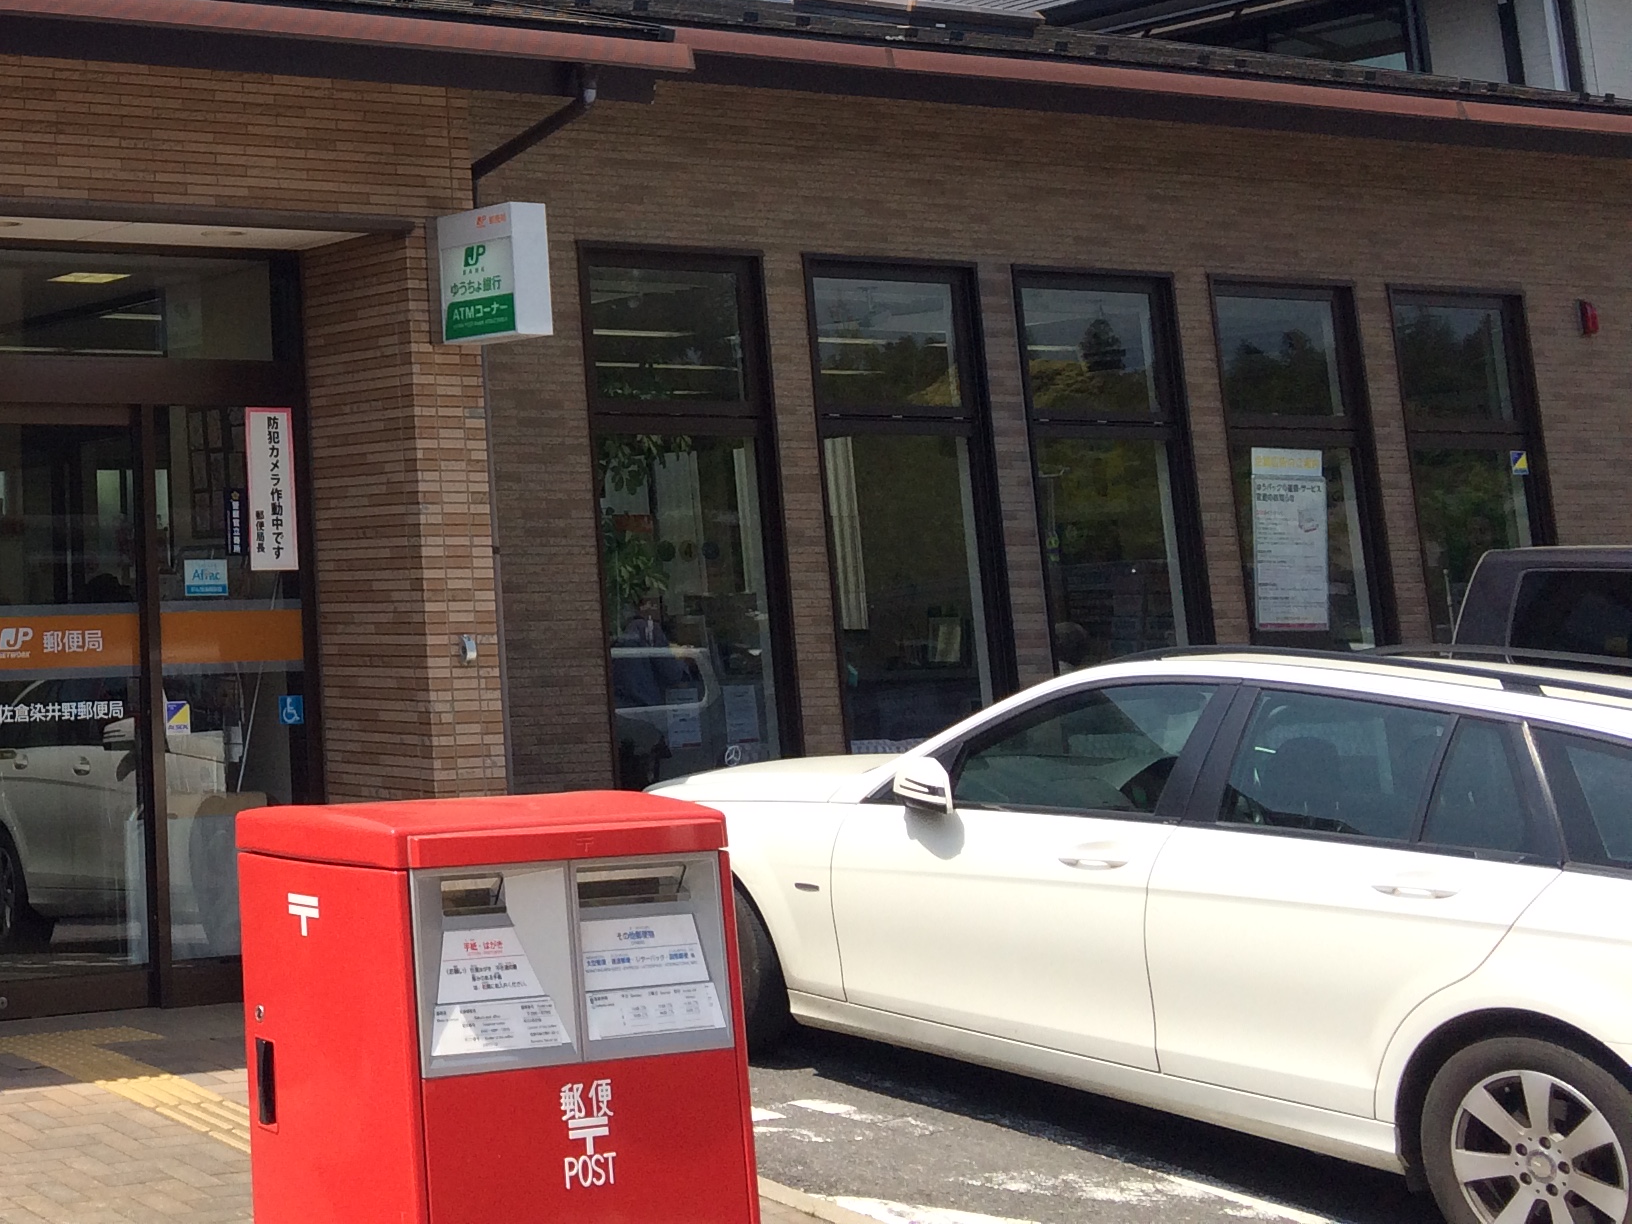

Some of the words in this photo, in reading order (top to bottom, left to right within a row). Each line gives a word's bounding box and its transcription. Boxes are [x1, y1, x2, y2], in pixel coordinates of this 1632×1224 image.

[450, 275, 502, 297] ゆうちょ銀行
[452, 301, 509, 321] ATMコーナー
[266, 416, 285, 560] 防犯カメラ作動中です
[255, 510, 266, 554] 郵便局長
[43, 629, 103, 654] 郵便局
[559, 1078, 614, 1121] 郵便
[563, 1151, 617, 1190] POST
